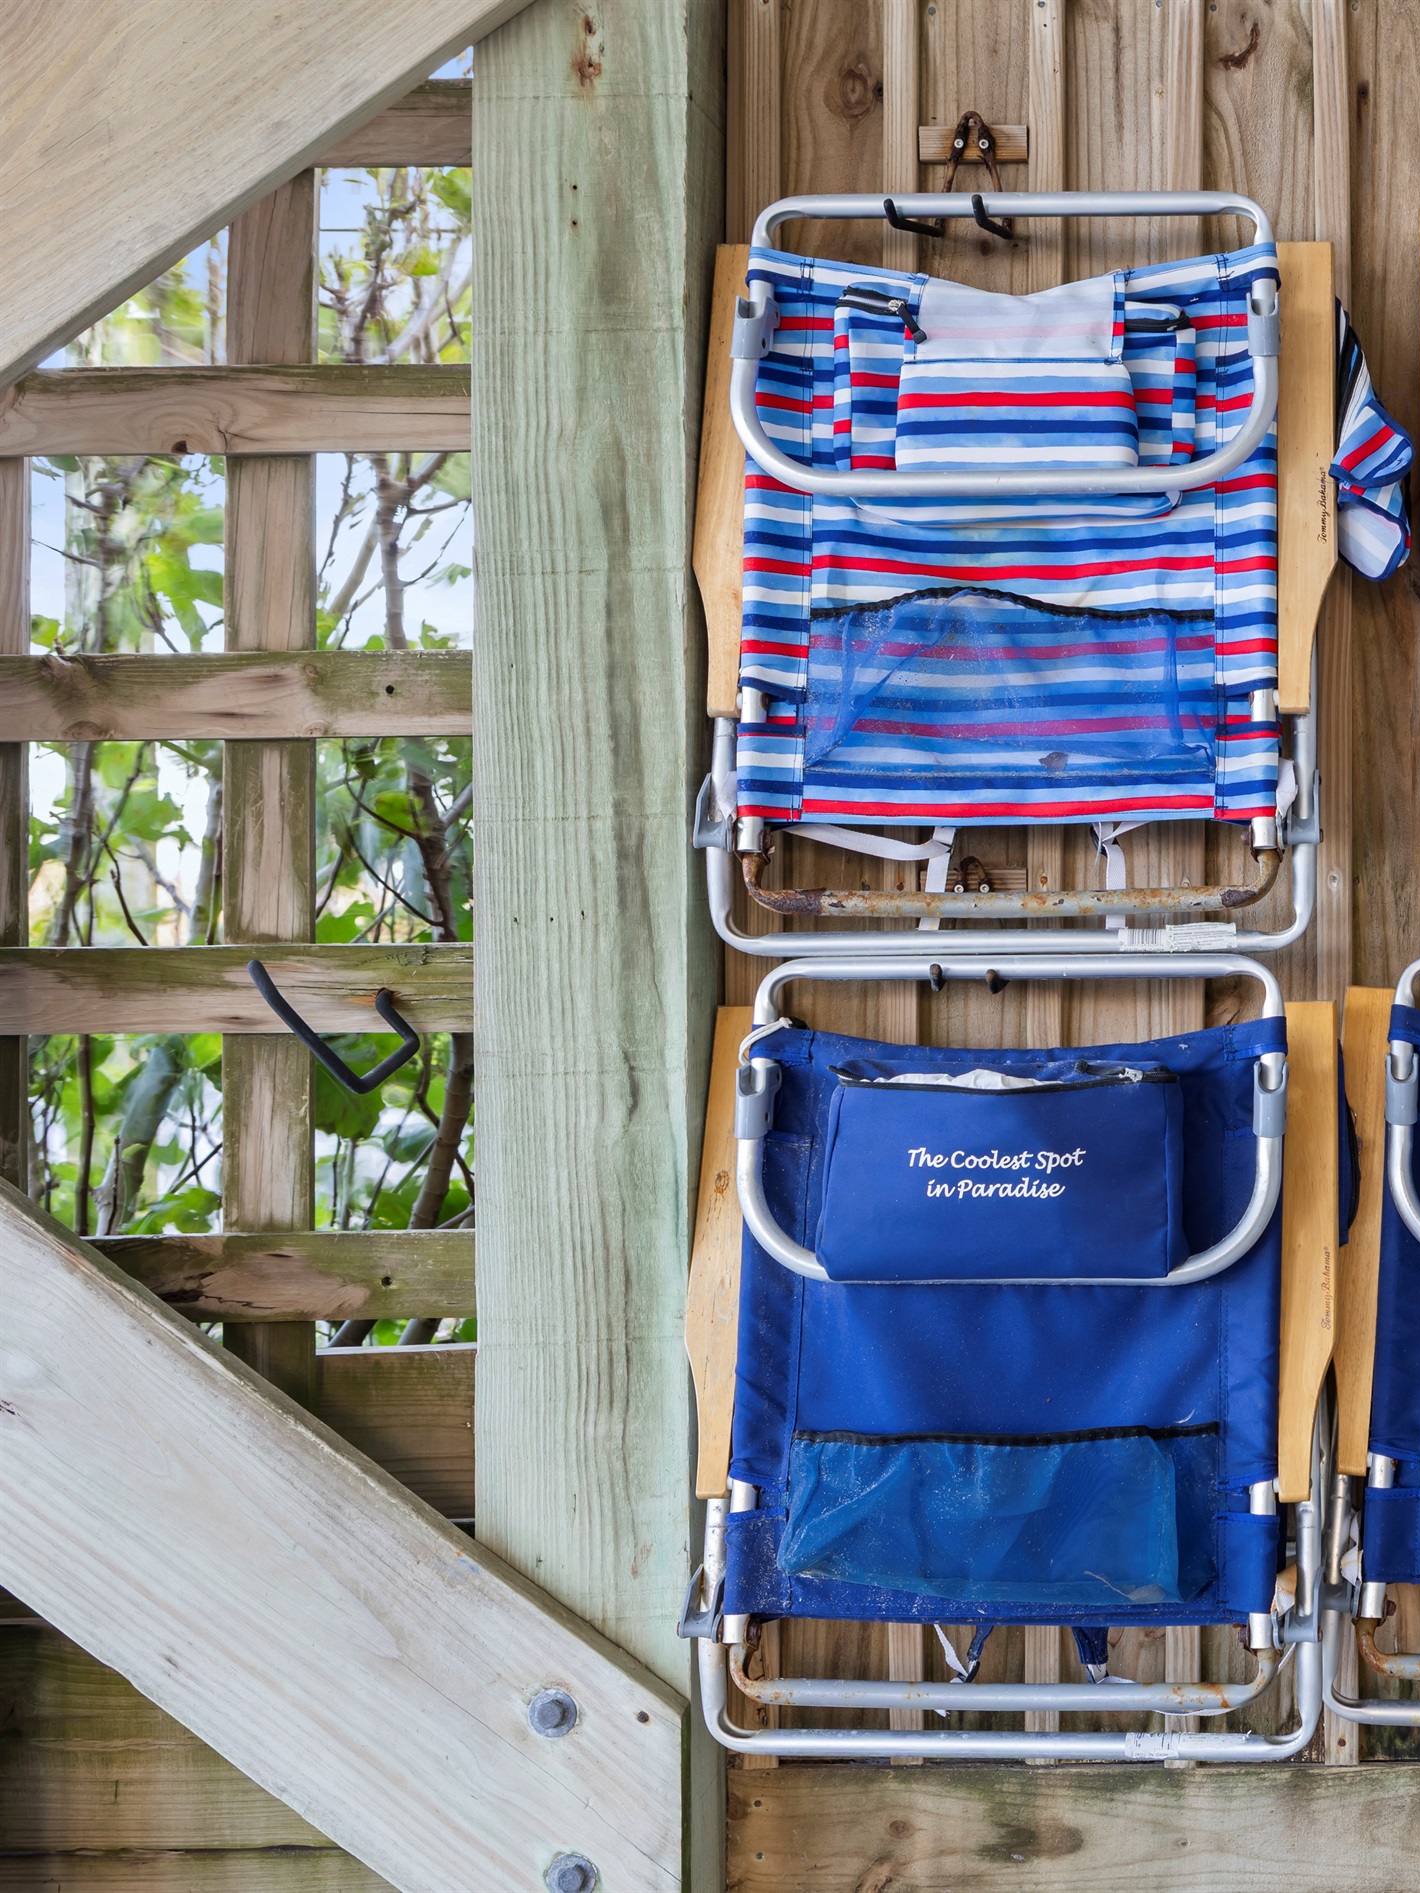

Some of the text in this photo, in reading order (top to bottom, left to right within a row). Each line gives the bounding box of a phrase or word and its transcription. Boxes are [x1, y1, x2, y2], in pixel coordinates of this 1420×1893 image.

[1316, 509, 1331, 544] Tommy
[907, 1147, 1087, 1175] The Coolest Spot
[926, 1177, 1066, 1199] in Paradise
[1320, 1291, 1332, 1330] Tommy
